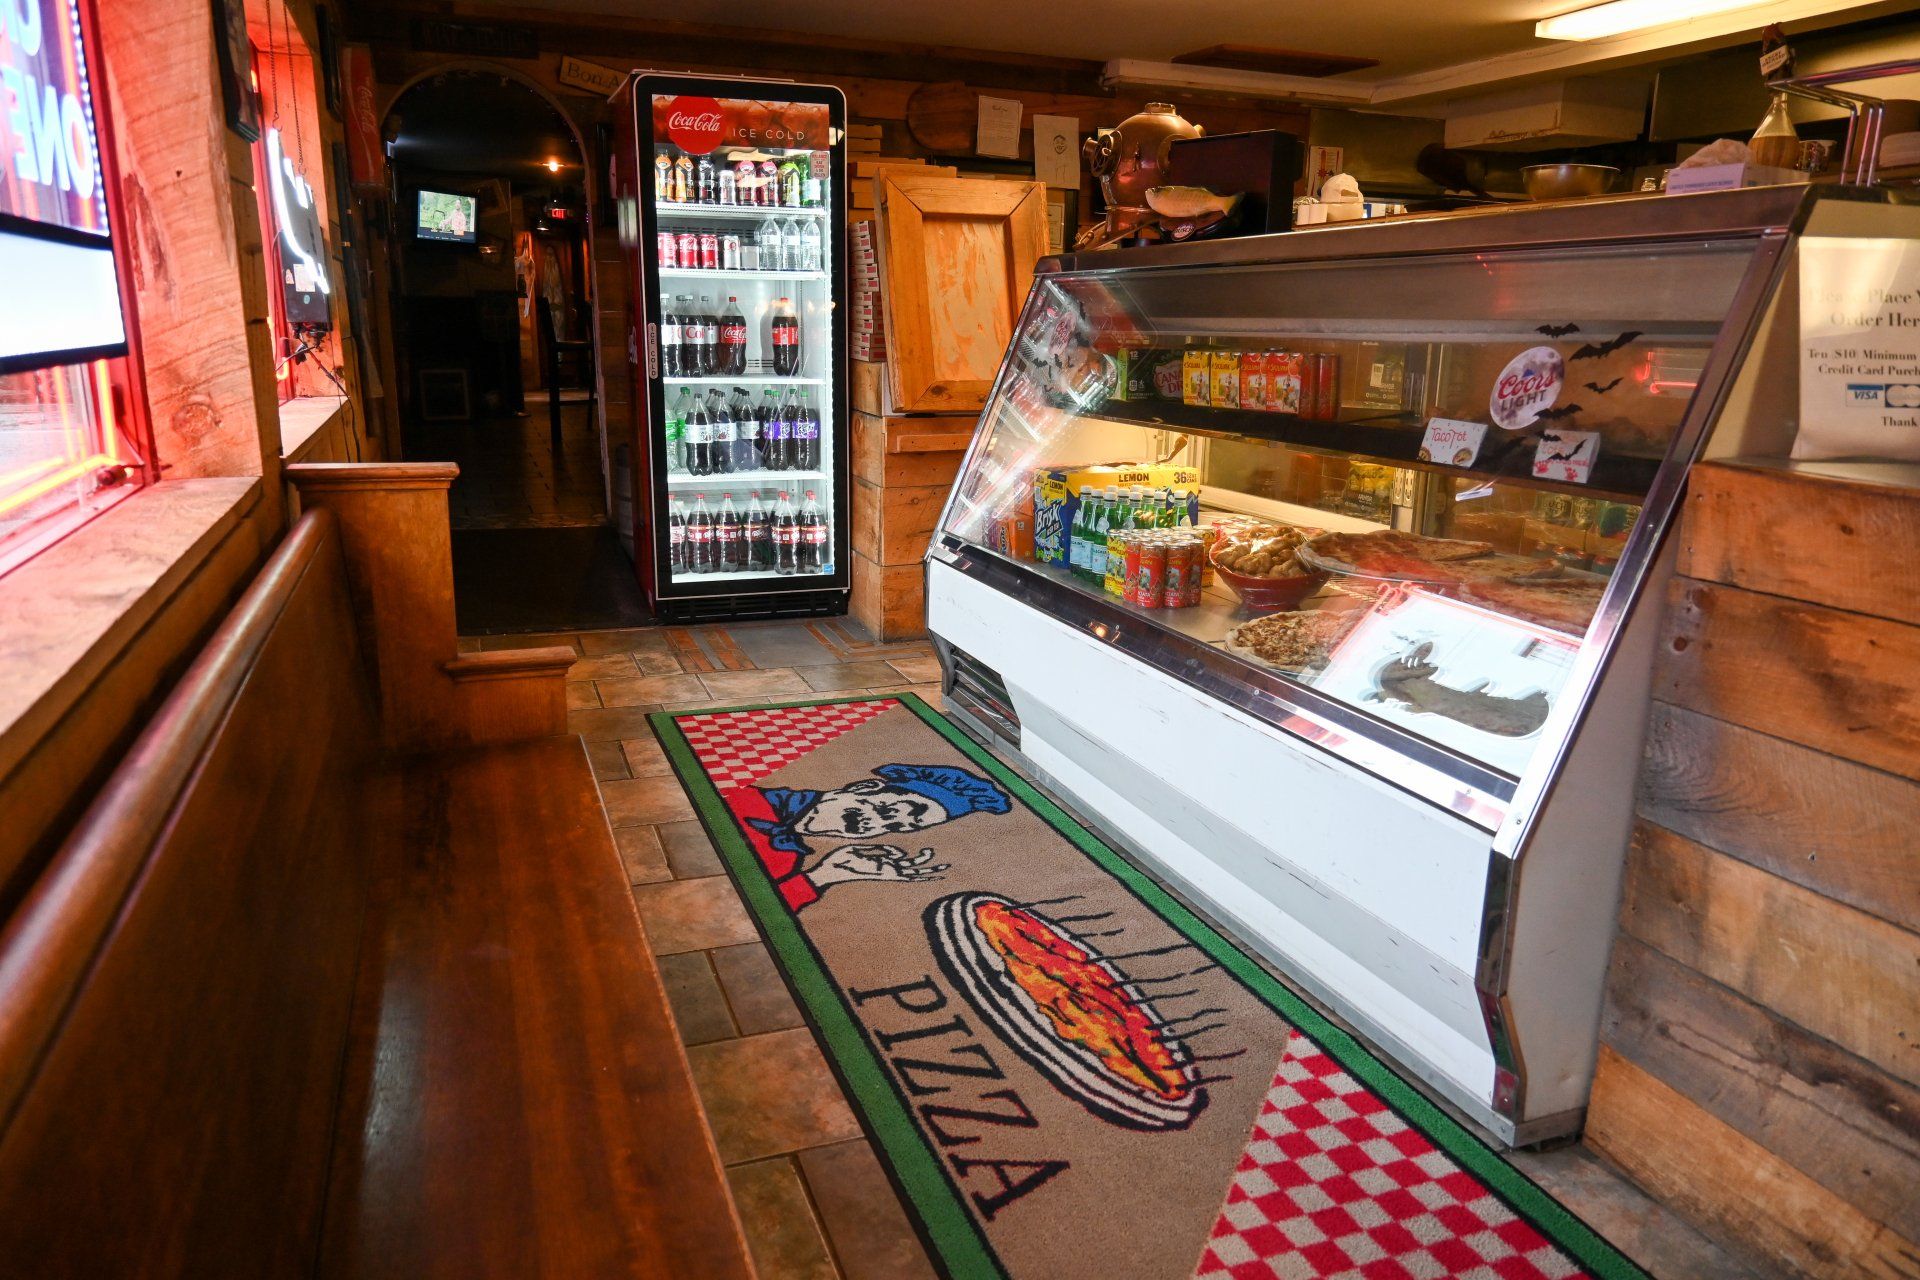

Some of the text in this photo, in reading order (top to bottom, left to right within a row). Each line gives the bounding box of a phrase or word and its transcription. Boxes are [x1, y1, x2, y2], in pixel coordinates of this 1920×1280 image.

[568, 62, 601, 85] Bon
[669, 112, 723, 132] Coca-Cola
[732, 128, 805, 141] ICE COLD
[1808, 288, 1912, 304] Plea Place
[1888, 312, 1920, 327] Her
[1807, 348, 1829, 359] Ten
[1862, 348, 1917, 361] Minimum
[1818, 363, 1920, 377] Credit Card Purch
[1155, 371, 1183, 388] CAN
[1498, 369, 1556, 399] Coors
[1501, 389, 1547, 412] LIGHT
[1854, 391, 1878, 400] VISA
[1881, 416, 1918, 427] Thank
[1118, 471, 1187, 484] LEMON 36
[1049, 481, 1064, 491] LEMON
[849, 975, 1070, 1221] PIZZA
